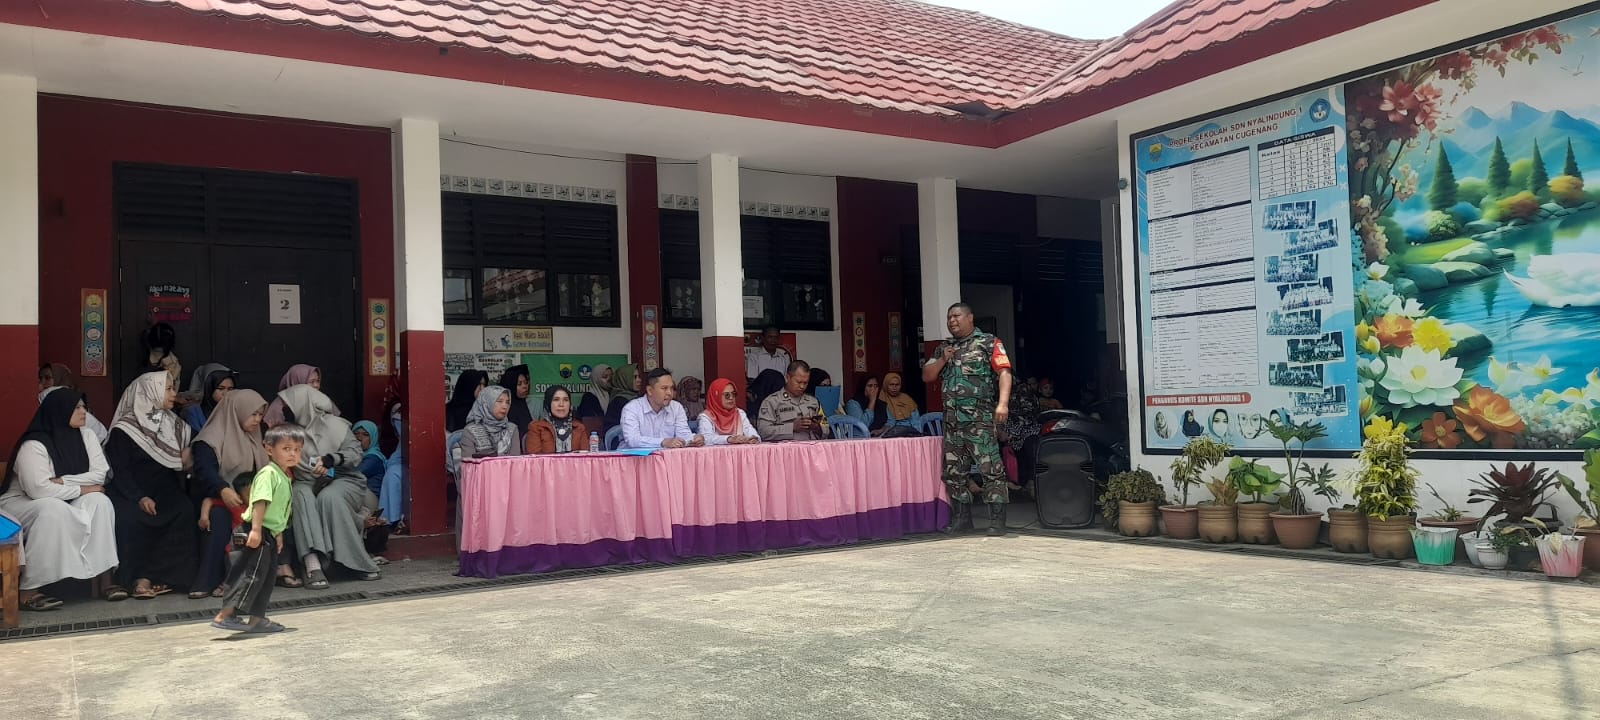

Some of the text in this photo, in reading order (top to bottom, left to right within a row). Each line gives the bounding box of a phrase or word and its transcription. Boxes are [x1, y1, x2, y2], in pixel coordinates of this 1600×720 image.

[1169, 137, 1194, 147] PROFIL
[1195, 127, 1228, 141] SEKOLAH
[1230, 121, 1246, 132] SDN
[1247, 108, 1297, 129] NYALINDUNG
[1190, 123, 1279, 151] KECAMATAN CUGENANG
[280, 299, 290, 310] 2
